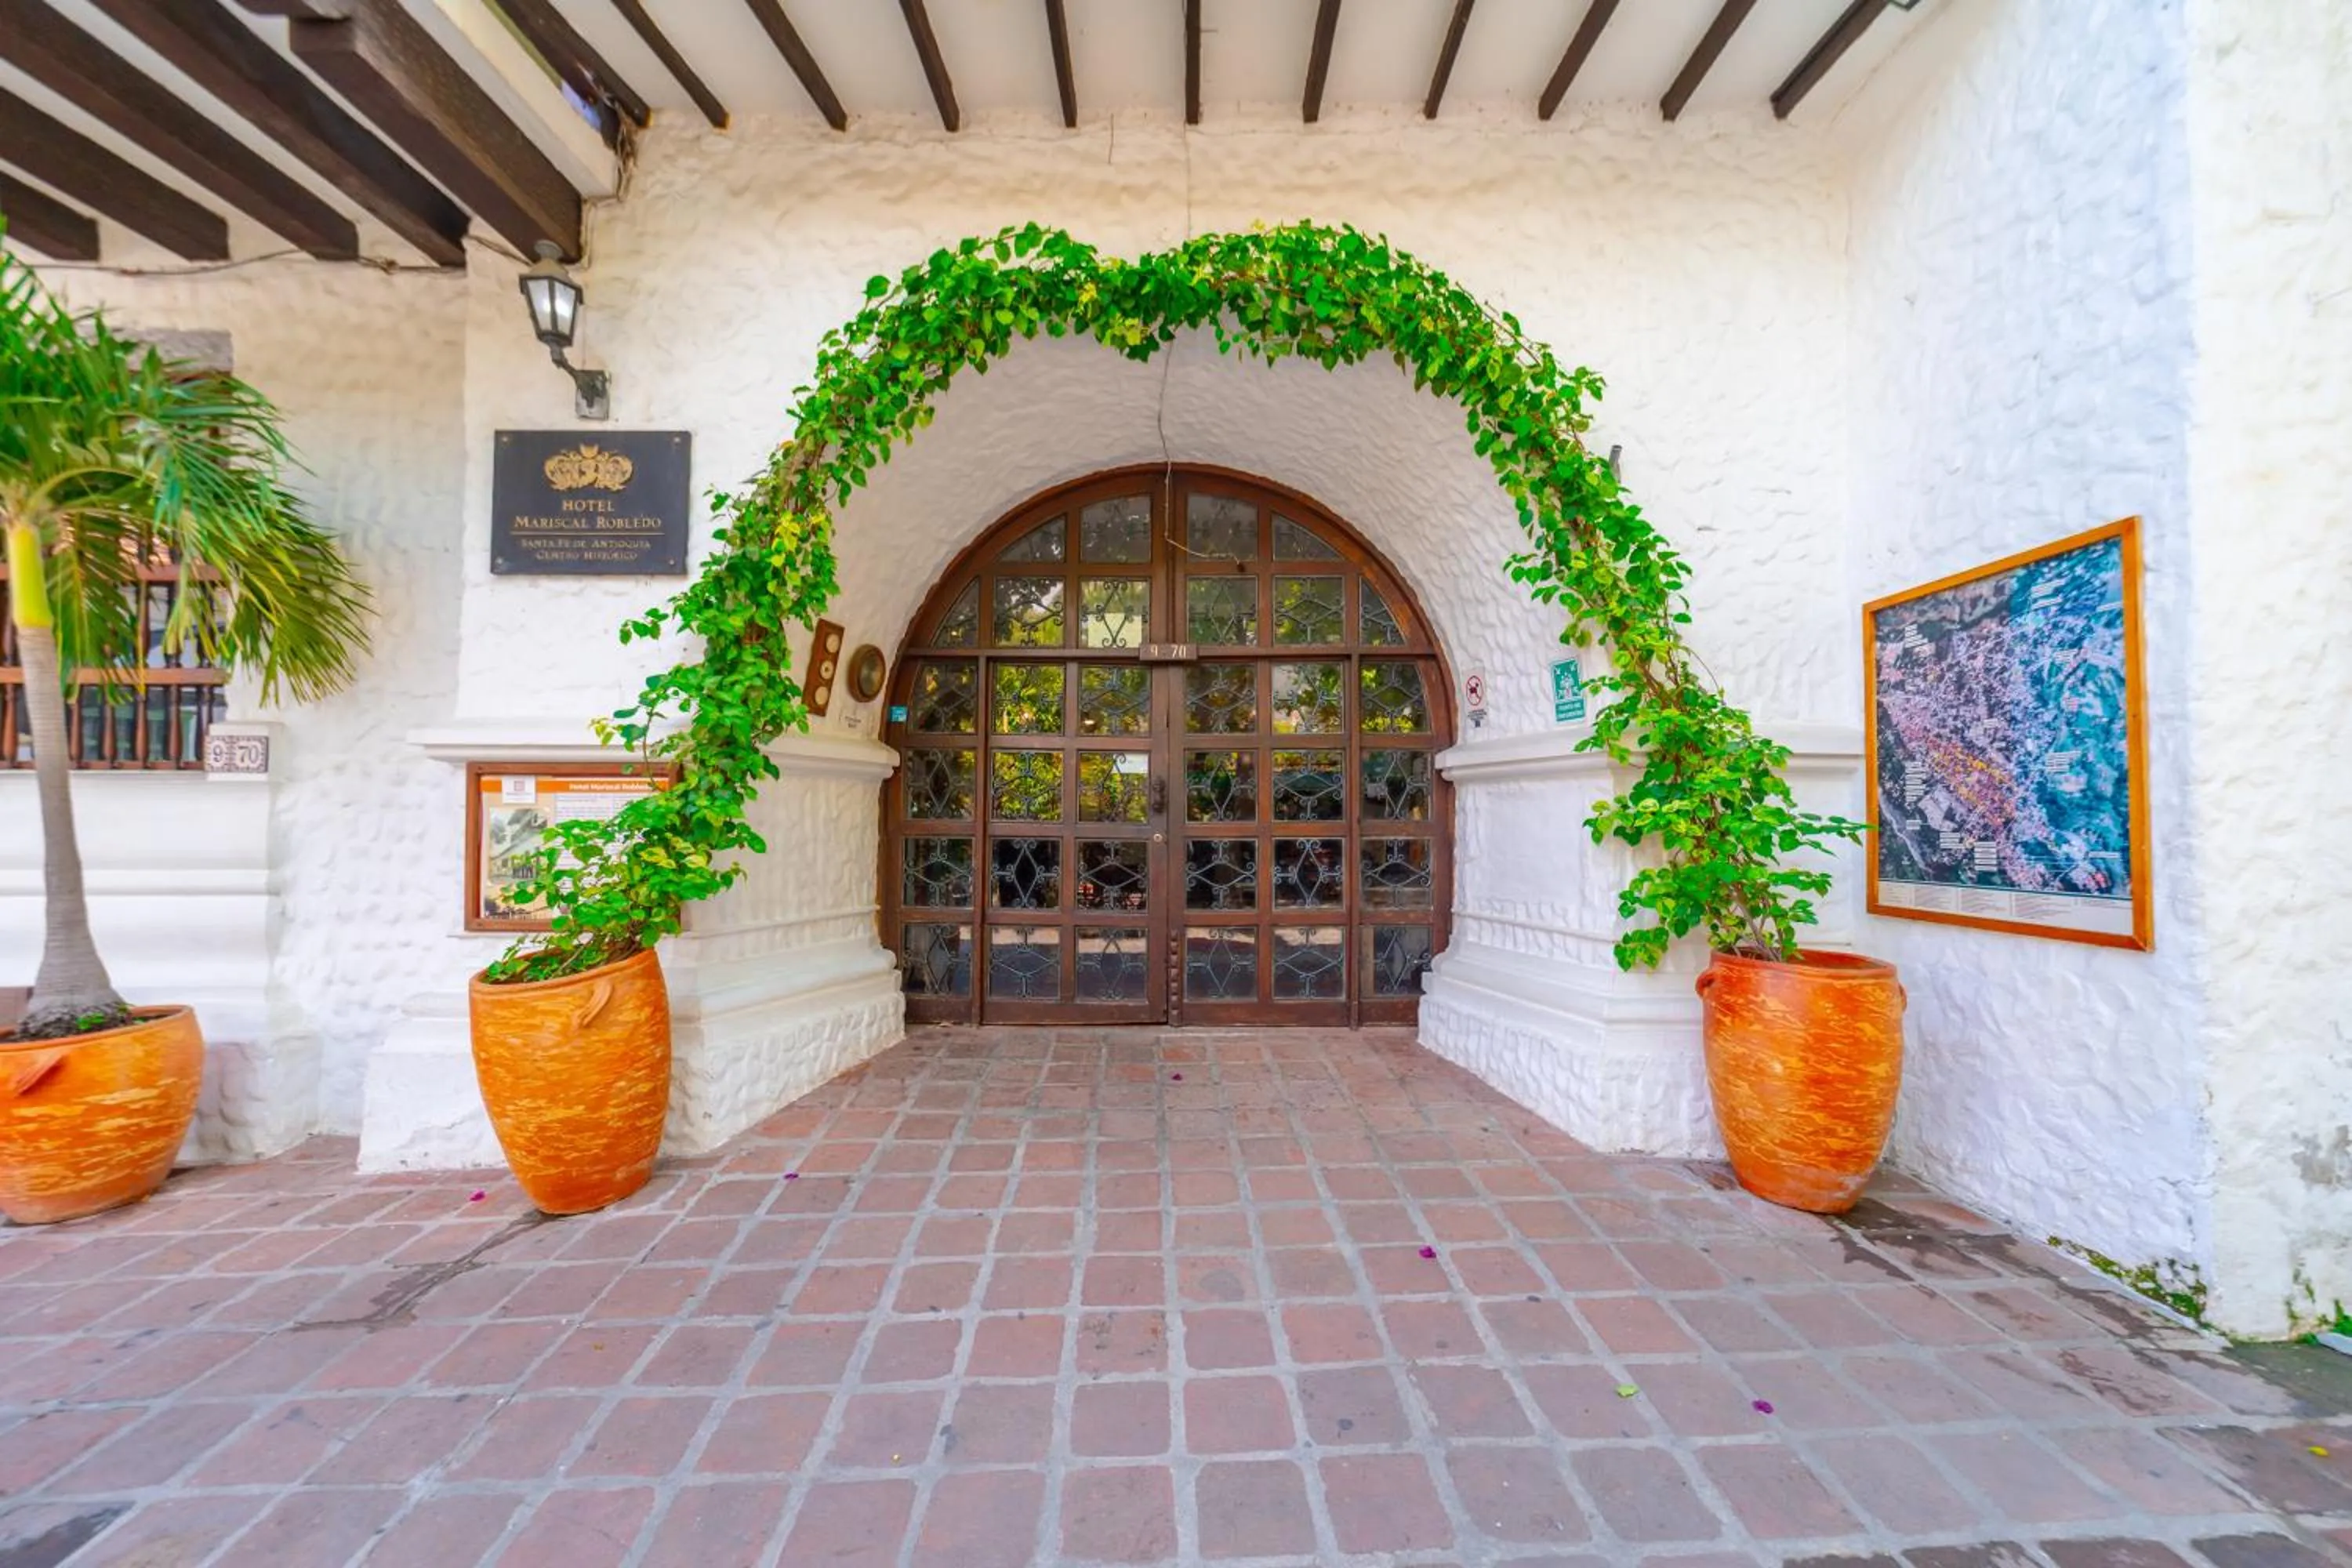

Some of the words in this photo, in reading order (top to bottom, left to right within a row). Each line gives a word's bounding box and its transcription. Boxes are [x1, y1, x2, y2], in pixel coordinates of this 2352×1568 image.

[562, 499, 614, 512] HOTEL
[514, 516, 587, 528] MARISCAL
[597, 516, 662, 528] ROBLEDO
[1150, 644, 1158, 657] 9
[1171, 644, 1186, 659] 70
[212, 744, 223, 764] 9
[238, 744, 260, 764] 70
